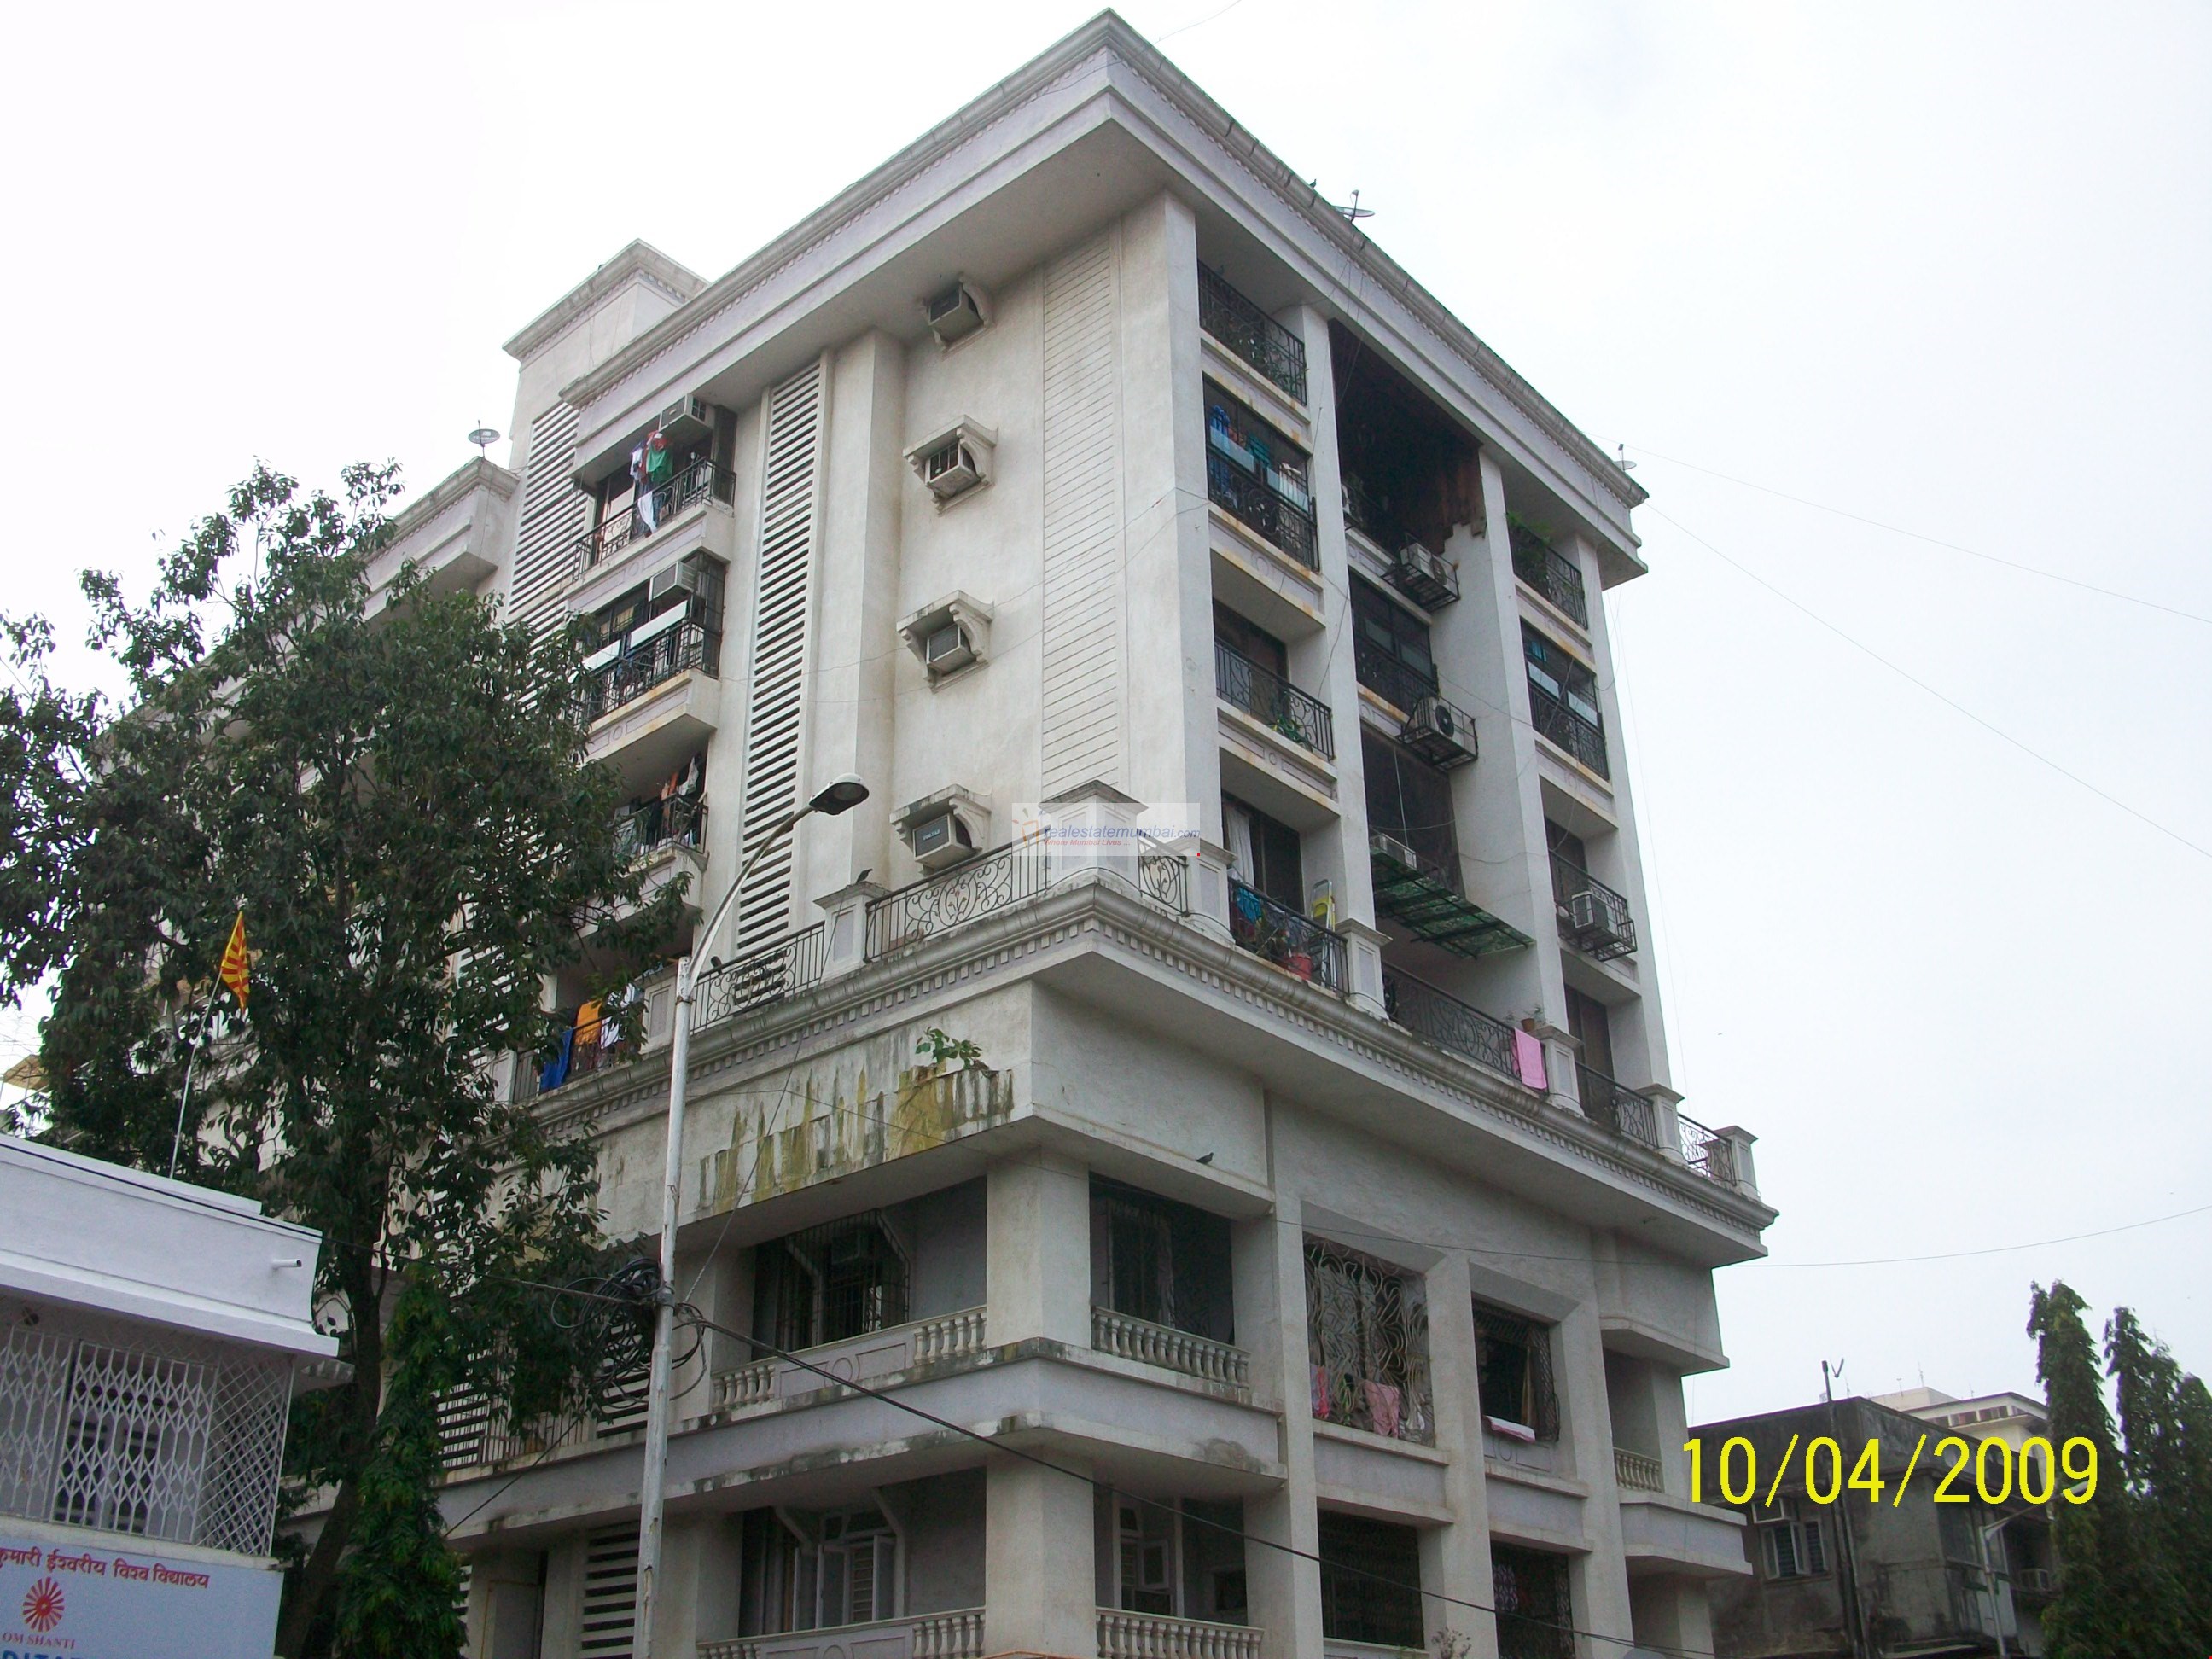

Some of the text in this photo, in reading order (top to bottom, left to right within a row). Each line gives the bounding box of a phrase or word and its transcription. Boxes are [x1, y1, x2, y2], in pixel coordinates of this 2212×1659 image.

[47, 1549, 107, 1575] ईश्वरीय
[113, 1557, 150, 1580] विश्व
[152, 1563, 210, 1588] विद्यालय
[3, 1632, 75, 1649] OM SHANTI
